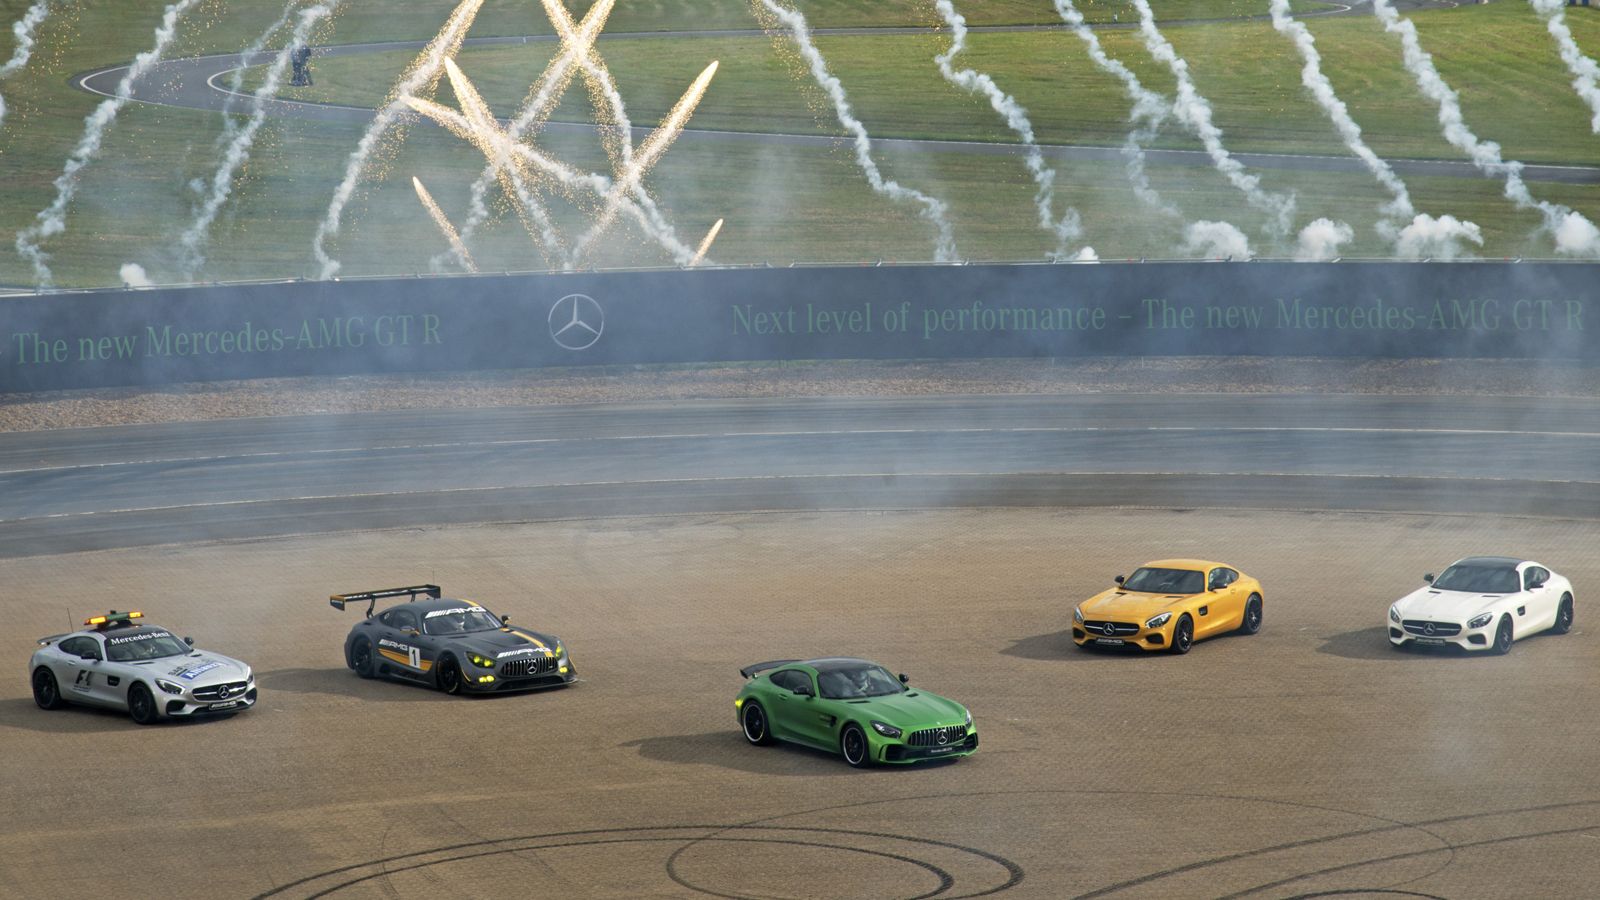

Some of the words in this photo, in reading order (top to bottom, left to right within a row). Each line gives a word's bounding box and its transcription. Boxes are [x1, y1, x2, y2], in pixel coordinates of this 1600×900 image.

[12, 332, 68, 364] The
[78, 336, 138, 361] new
[145, 315, 366, 357] Mercedes-AMG
[374, 315, 414, 346] GT
[423, 314, 442, 344] R
[732, 304, 796, 335] Next
[807, 302, 872, 333] level
[883, 301, 911, 332] of
[923, 300, 1106, 339] performance
[1142, 299, 1195, 329] The
[1205, 305, 1264, 329] new
[1276, 298, 1500, 330] Mercedes-AMG
[1512, 299, 1552, 331] GT
[1565, 300, 1585, 330] R
[111, 632, 170, 645] Mercedes-Benz
